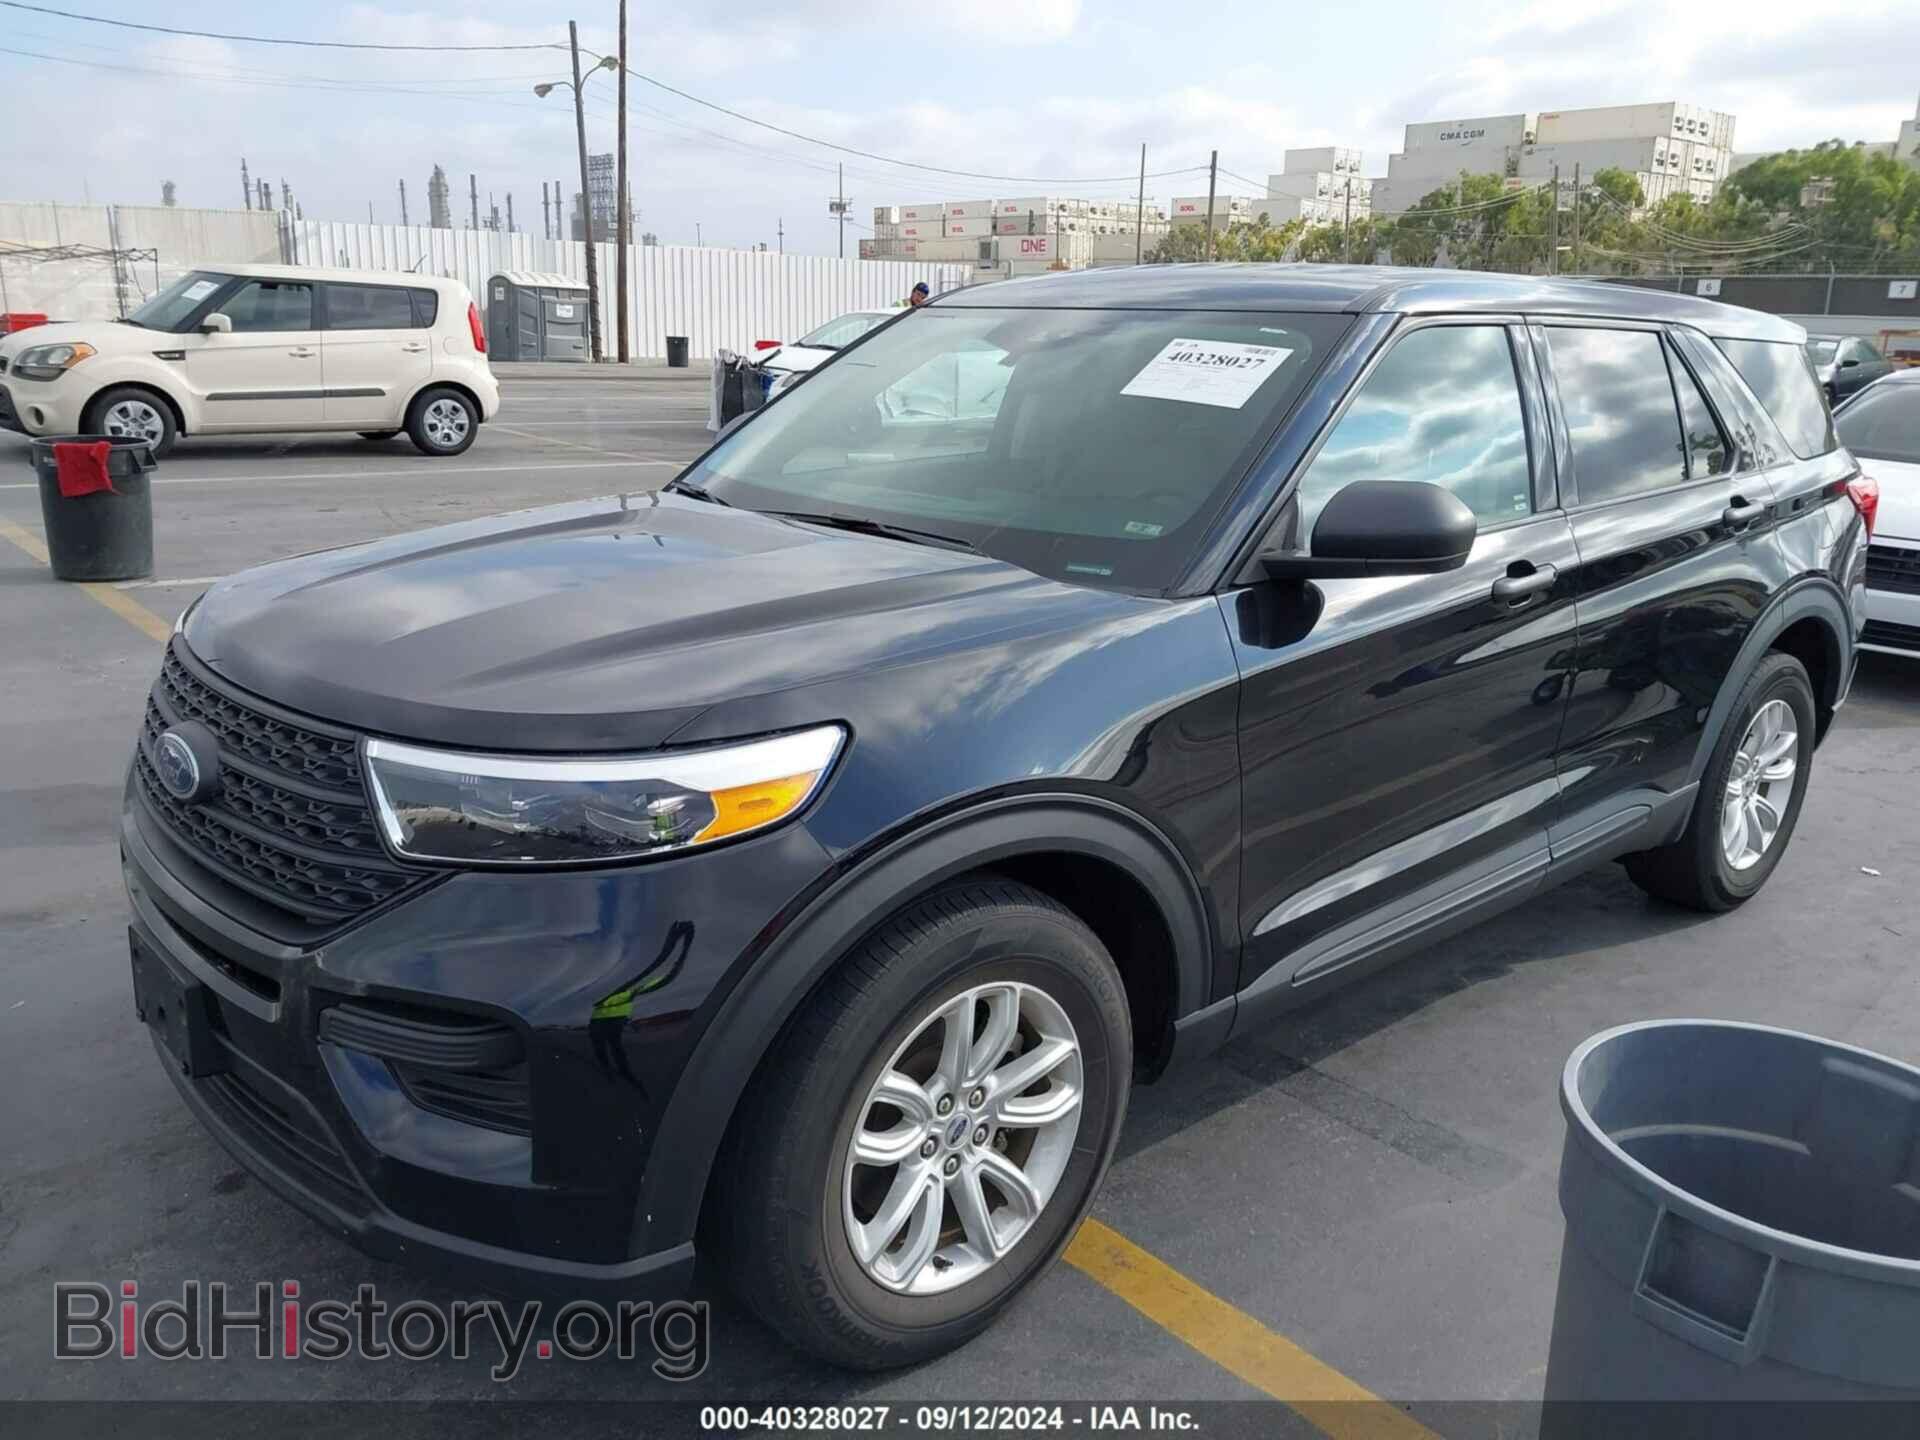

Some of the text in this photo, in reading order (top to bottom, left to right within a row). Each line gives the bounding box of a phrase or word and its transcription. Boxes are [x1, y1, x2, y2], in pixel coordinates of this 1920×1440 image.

[1440, 129, 1485, 141] CMA CGM
[1021, 238, 1046, 253] ONE
[1167, 350, 1267, 370] 40328027
